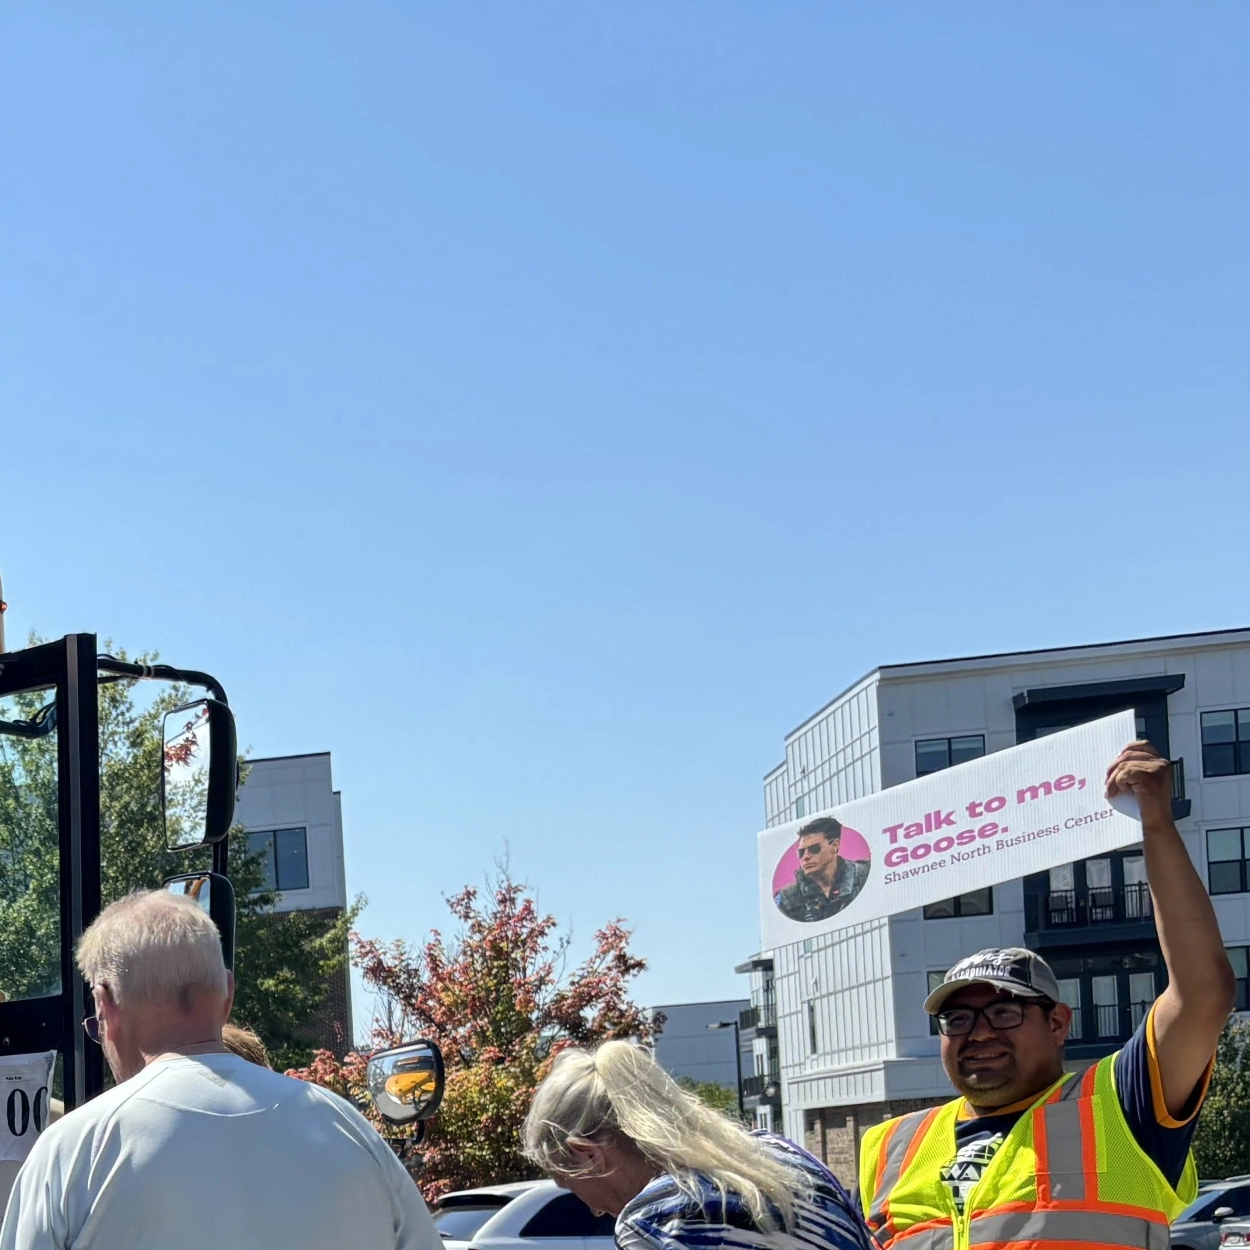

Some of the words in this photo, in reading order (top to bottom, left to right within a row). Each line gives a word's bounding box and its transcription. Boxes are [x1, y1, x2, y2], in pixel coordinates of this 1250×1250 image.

[882, 809, 957, 844] Talk
[965, 796, 1007, 819] to
[1016, 774, 1086, 804] me,
[883, 821, 1009, 868] Goose.
[884, 859, 946, 885] Shawnee
[950, 843, 991, 864] North
[995, 824, 1060, 851] Business
[1064, 808, 1114, 830] Center
